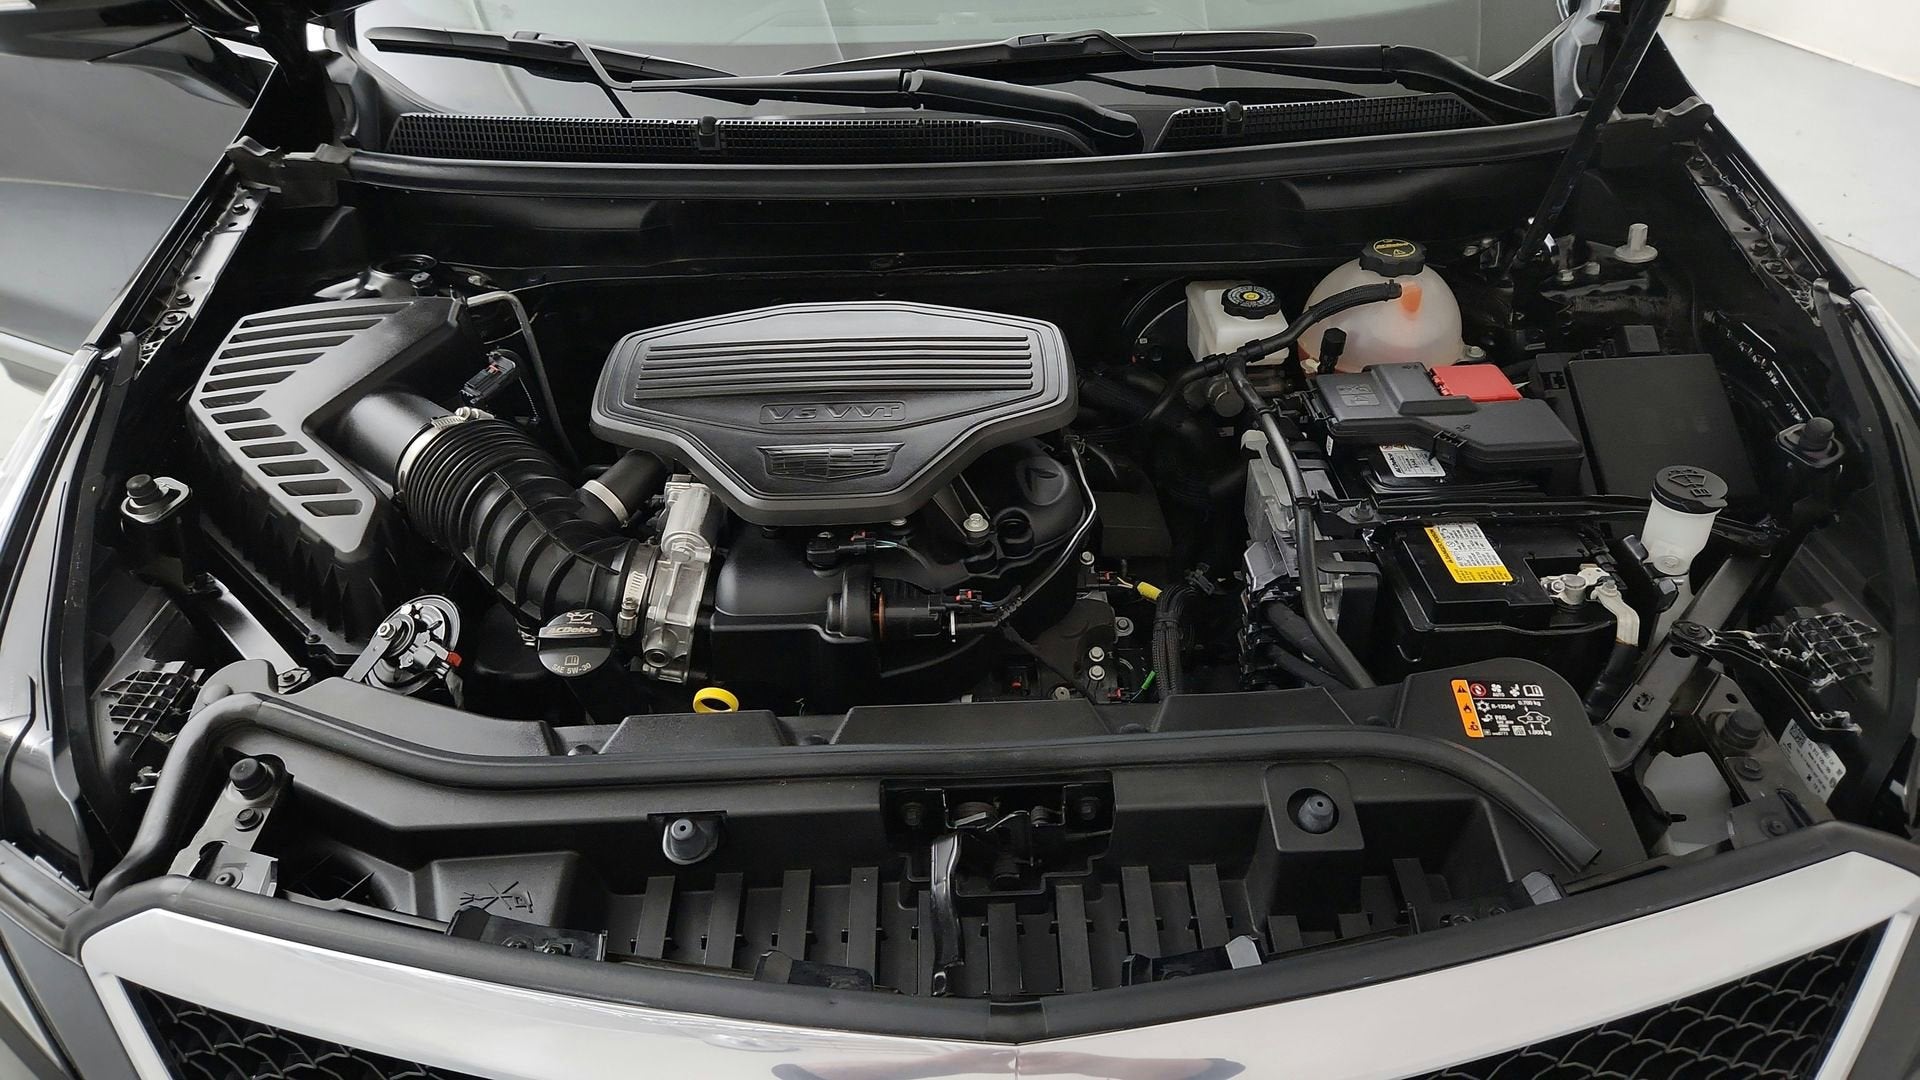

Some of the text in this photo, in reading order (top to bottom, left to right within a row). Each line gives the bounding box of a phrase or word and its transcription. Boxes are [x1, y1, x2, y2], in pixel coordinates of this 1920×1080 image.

[824, 405, 900, 418] VVT
[551, 662, 592, 674] SAE 5W-30
